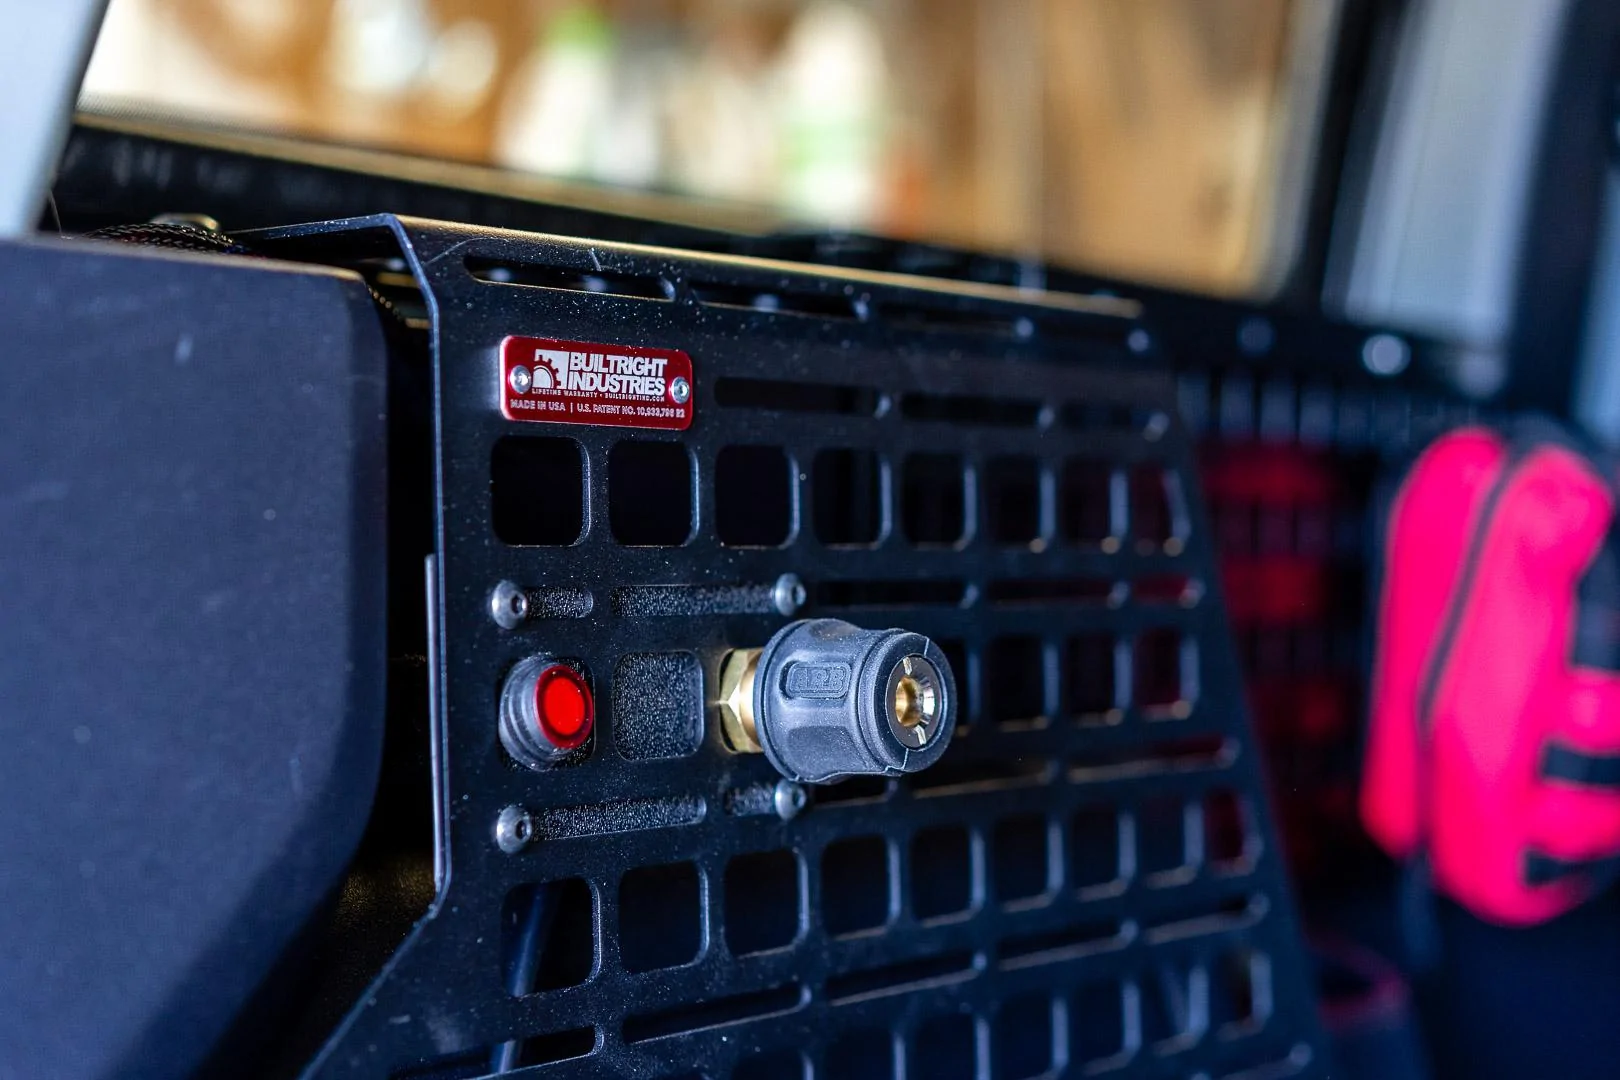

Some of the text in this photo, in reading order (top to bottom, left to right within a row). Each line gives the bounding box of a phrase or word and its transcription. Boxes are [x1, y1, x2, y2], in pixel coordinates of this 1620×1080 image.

[570, 351, 668, 377] BUILTRIGHT
[532, 388, 561, 396] LIFETIME
[564, 390, 598, 398] WARRANTY
[568, 371, 666, 396] INDUSTRIES
[510, 399, 536, 410] MADE
[537, 400, 546, 410] IN
[548, 401, 566, 411] USA
[577, 403, 591, 413] U.S.
[593, 404, 621, 414] PATENT
[622, 406, 635, 415] NO.
